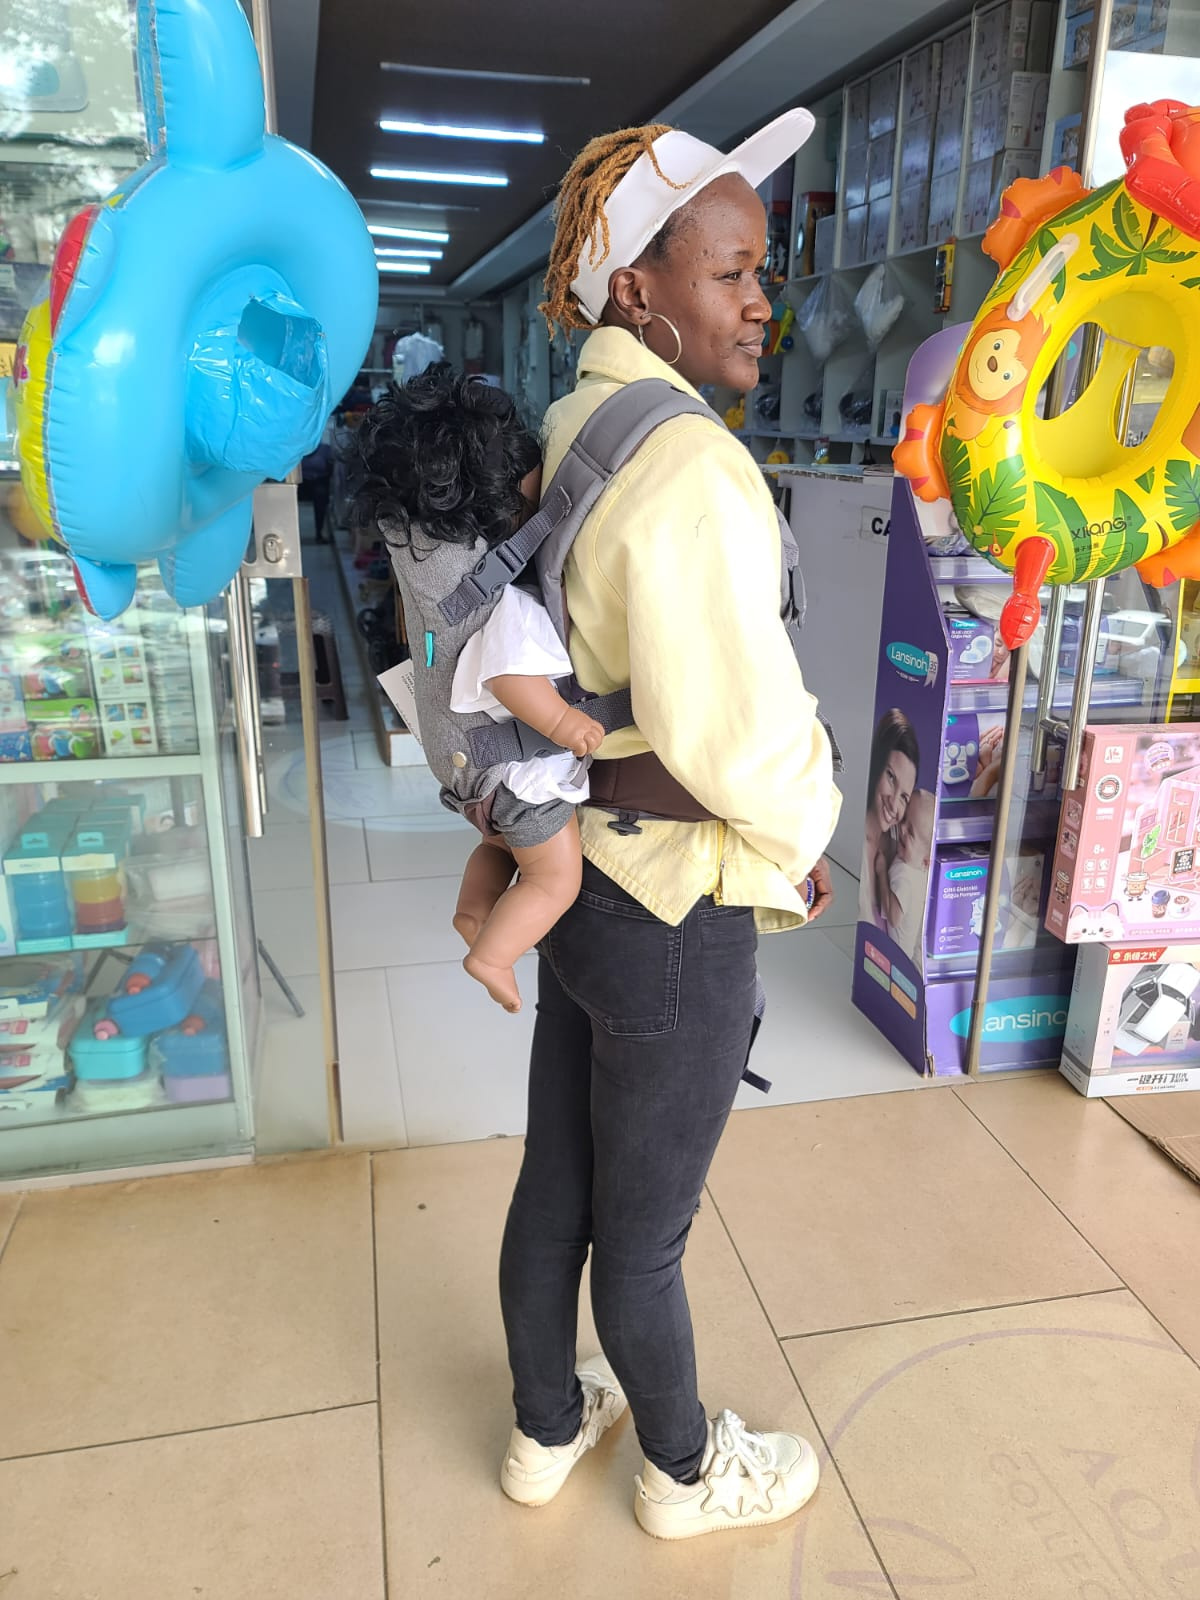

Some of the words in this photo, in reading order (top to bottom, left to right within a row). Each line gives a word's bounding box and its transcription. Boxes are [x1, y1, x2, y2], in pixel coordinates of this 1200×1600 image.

[891, 646, 929, 672] Lansinoh
[949, 869, 983, 879] Lansinoh
[981, 1009, 1068, 1033] ansino
